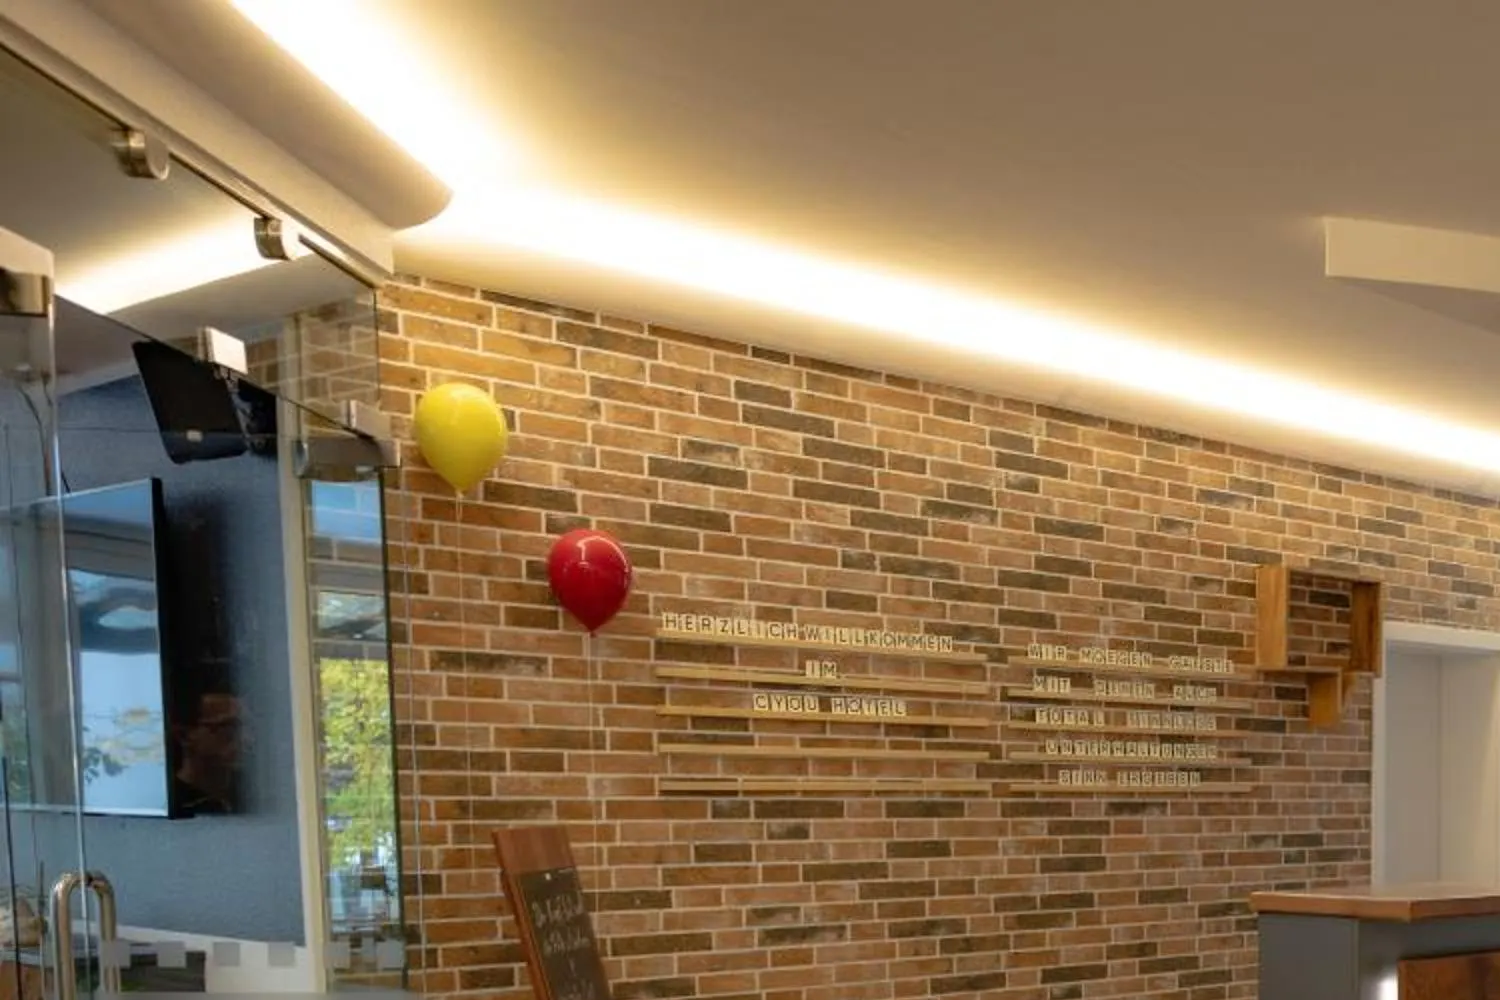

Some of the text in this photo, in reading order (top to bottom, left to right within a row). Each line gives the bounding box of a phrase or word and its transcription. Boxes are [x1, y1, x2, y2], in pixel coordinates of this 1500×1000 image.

[1027, 643, 1067, 661] WIR
[807, 661, 836, 678] IM
[1033, 677, 1070, 693] MIT
[754, 694, 906, 716] CYOU HOTEL
